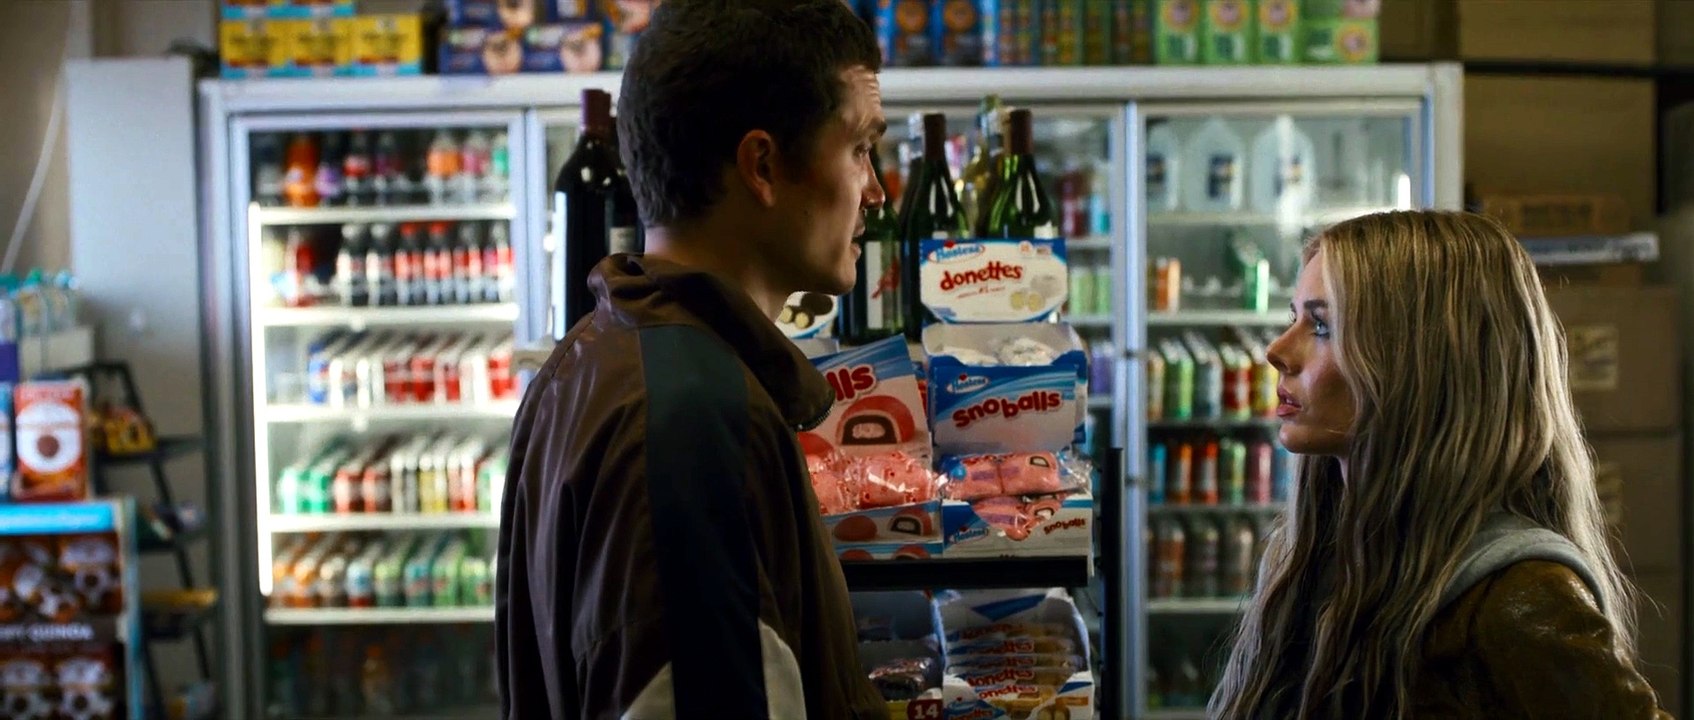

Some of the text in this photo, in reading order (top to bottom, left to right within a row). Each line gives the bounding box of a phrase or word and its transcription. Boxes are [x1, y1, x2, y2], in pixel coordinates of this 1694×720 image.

[940, 261, 1023, 291] donettes
[826, 366, 875, 401] lls
[978, 685, 1036, 699] onettes
[914, 704, 939, 720] 14
